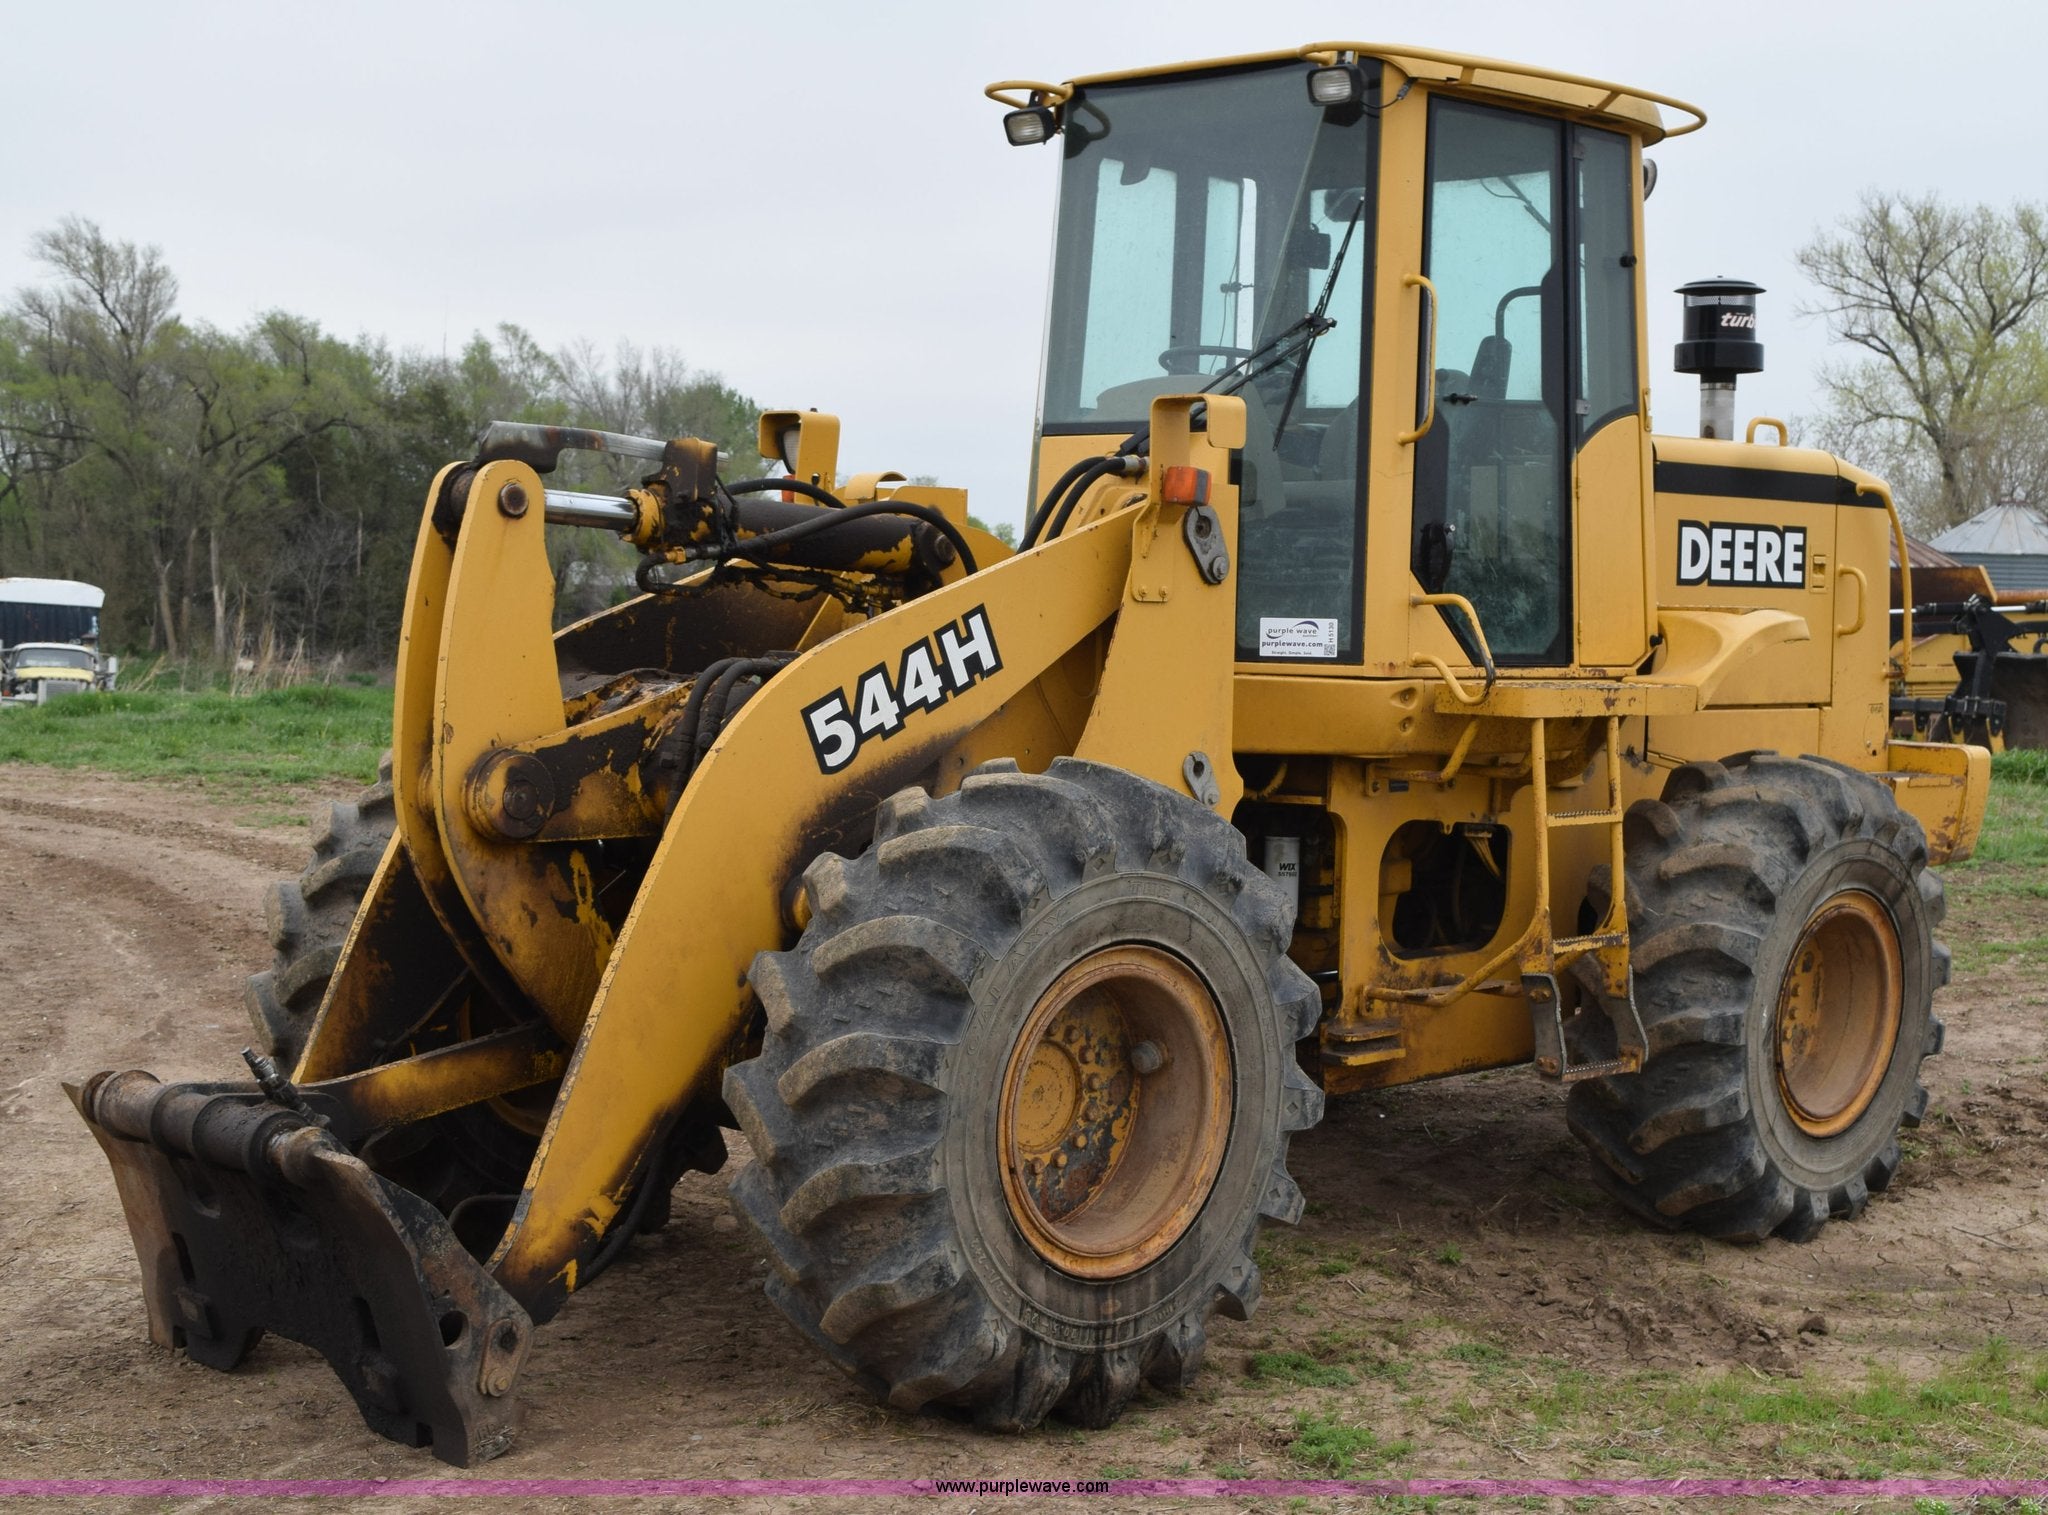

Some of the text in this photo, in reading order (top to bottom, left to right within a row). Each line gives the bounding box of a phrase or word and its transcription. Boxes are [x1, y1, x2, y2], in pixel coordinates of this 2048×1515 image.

[1720, 311, 1756, 329] turb
[1679, 525, 1804, 583] DEERE
[1261, 640, 1323, 648] purplewave.com
[809, 612, 997, 768] 544H
[1279, 862, 1297, 871] WIX
